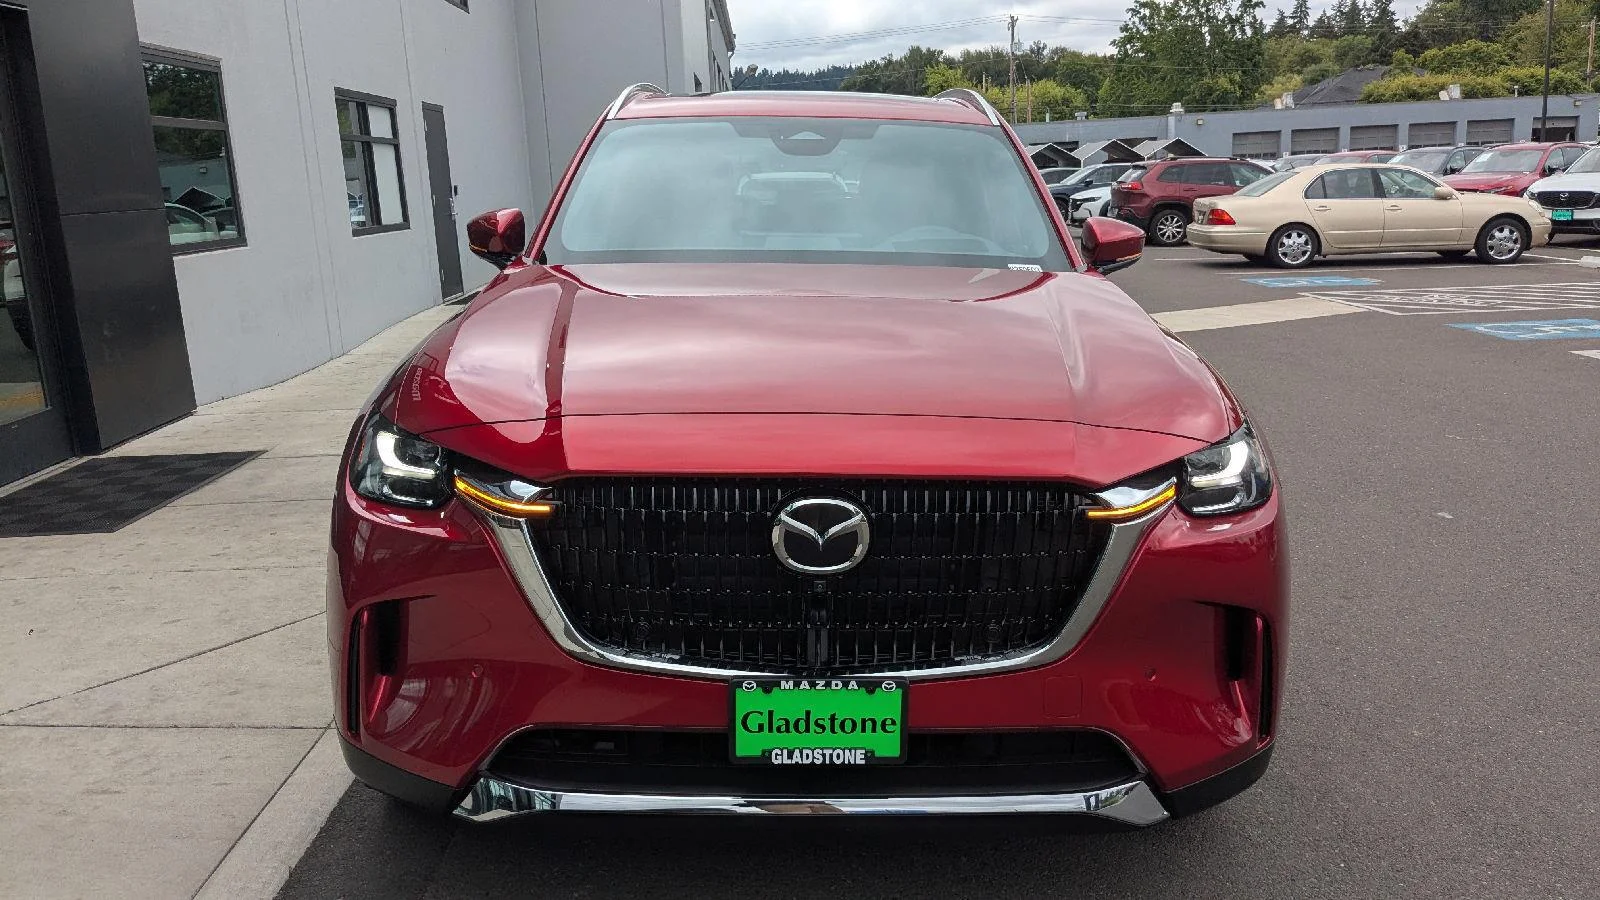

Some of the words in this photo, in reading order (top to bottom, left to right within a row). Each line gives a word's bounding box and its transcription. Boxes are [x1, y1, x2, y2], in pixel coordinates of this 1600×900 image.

[780, 680, 859, 690] MAZDA
[740, 709, 897, 735] Gladstone
[771, 748, 866, 765] GLADSTONE
